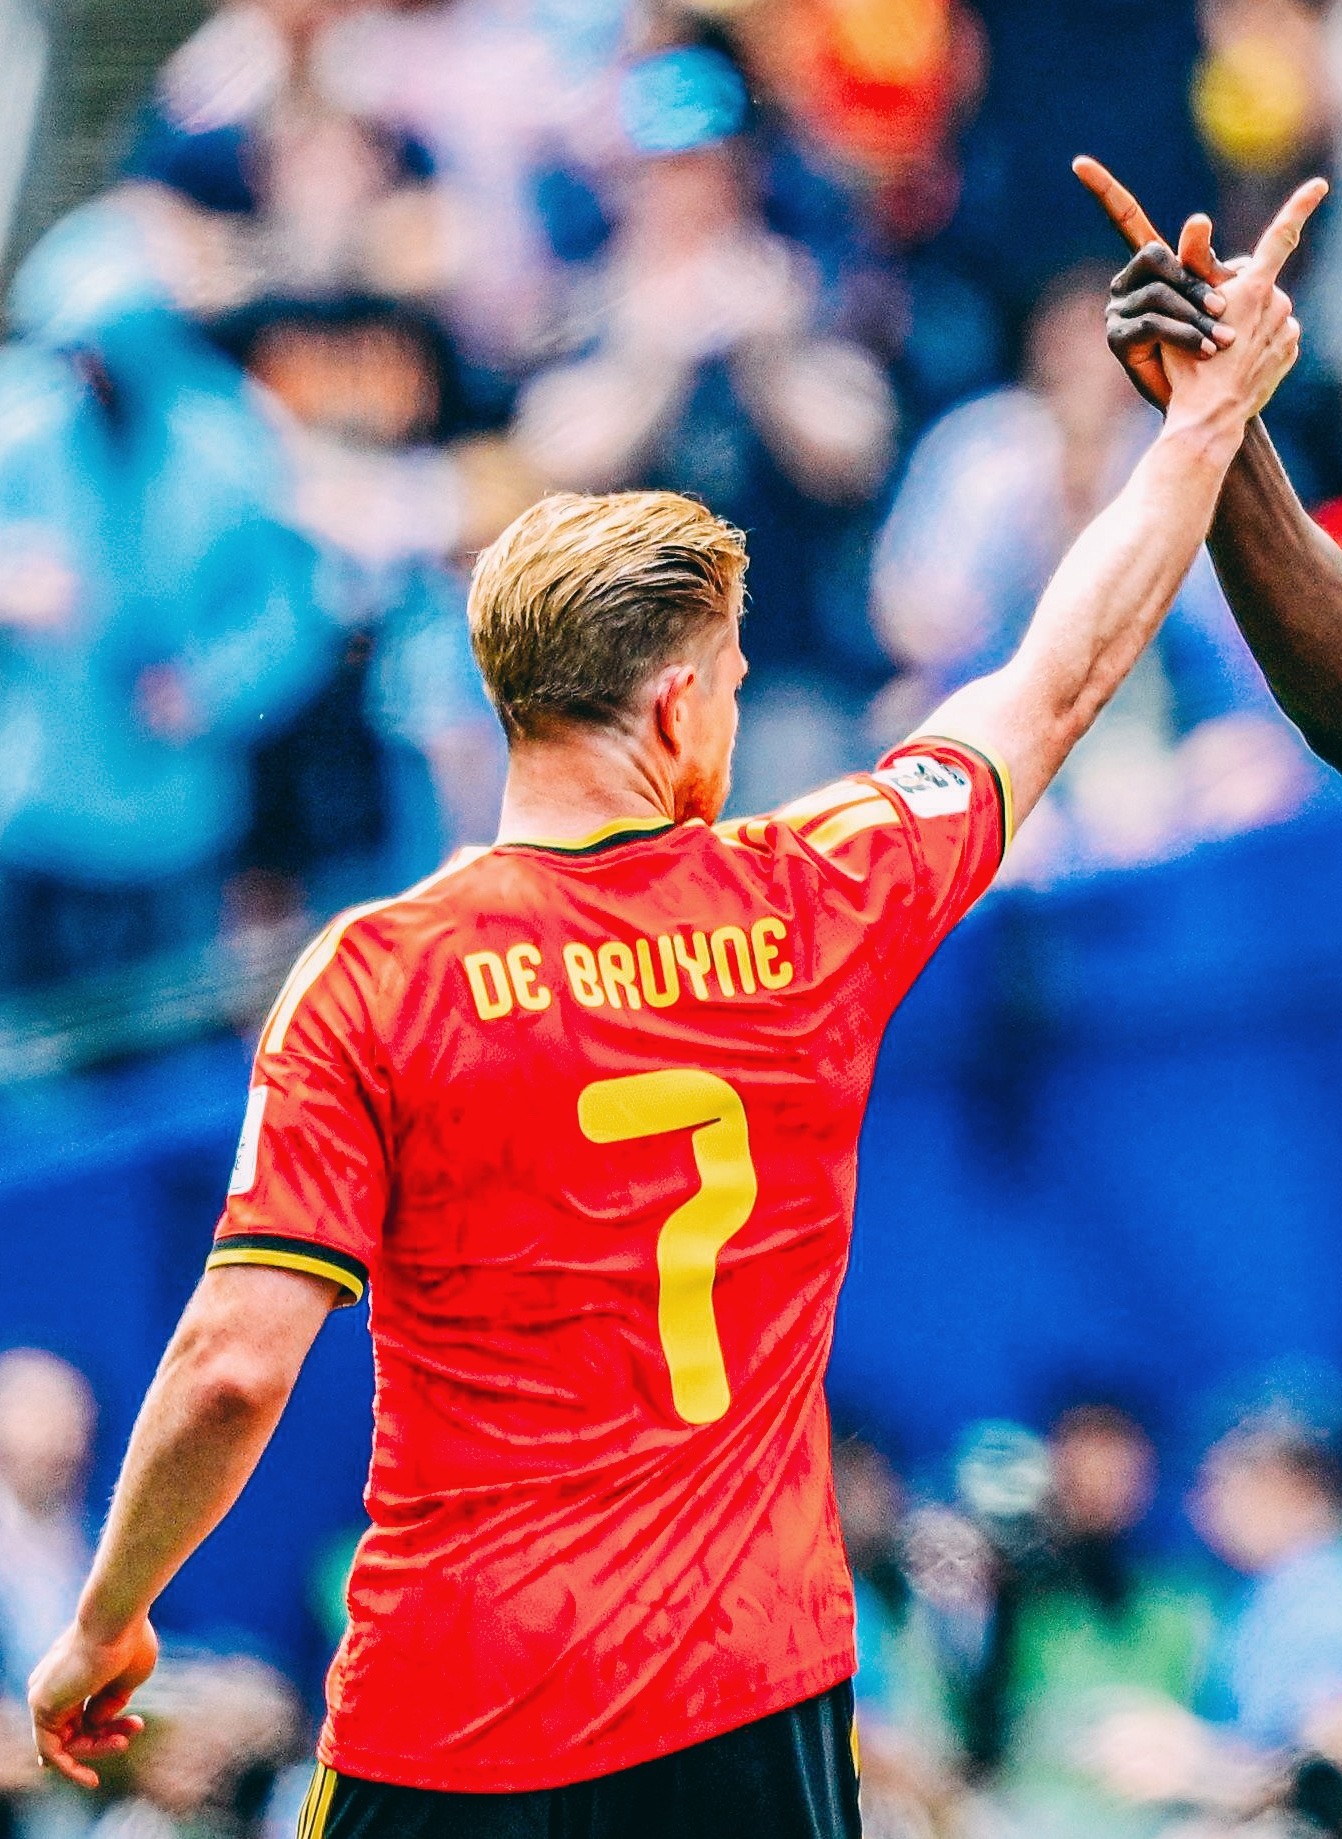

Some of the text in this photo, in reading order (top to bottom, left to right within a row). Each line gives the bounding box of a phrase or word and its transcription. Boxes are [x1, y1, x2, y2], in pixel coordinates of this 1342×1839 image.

[464, 917, 793, 1021] DE BRUYNE
[577, 1068, 757, 1424] 7
